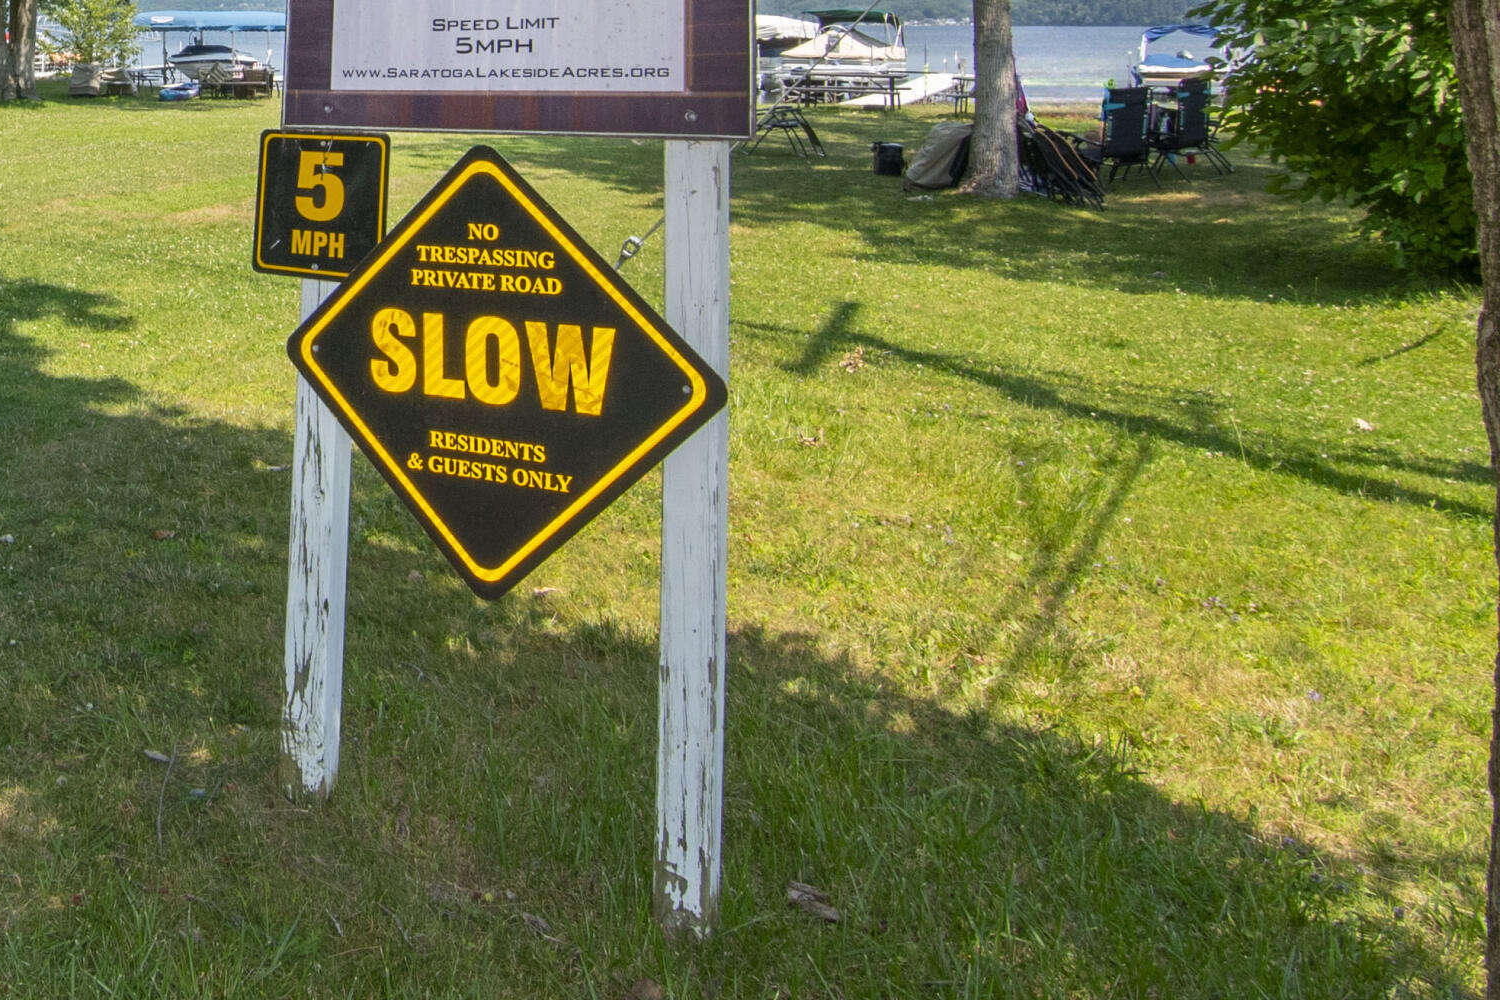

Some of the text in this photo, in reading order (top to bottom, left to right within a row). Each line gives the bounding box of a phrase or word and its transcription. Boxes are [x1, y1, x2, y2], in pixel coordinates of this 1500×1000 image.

[433, 17, 559, 31] SPEED LIMIT
[456, 37, 532, 54] 5MPH
[295, 151, 344, 221] 5
[291, 229, 344, 258] MPH
[468, 223, 499, 241] NO
[417, 245, 555, 270] TRESPASSING
[411, 268, 563, 295] PRIVATE ROAD
[370, 307, 616, 416] SLOW
[429, 431, 545, 463] RESIDENTS
[407, 452, 572, 493] & GUESTS ONLY
